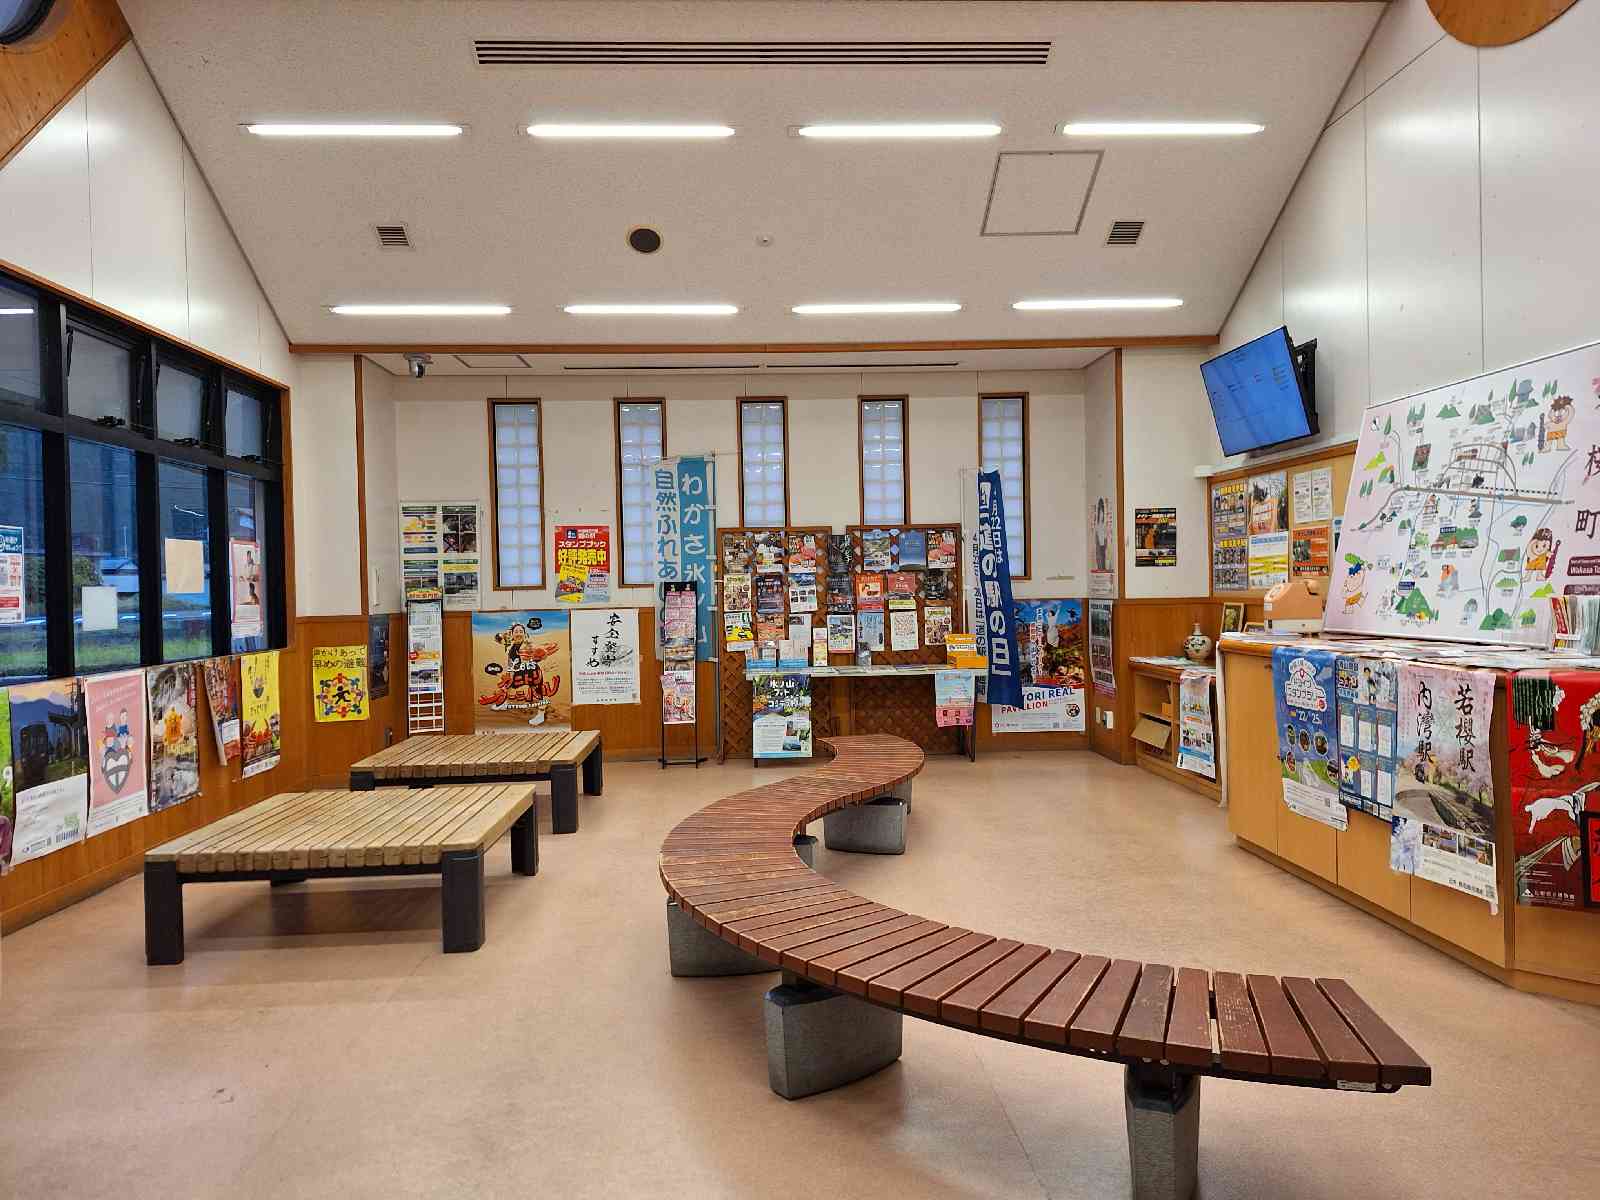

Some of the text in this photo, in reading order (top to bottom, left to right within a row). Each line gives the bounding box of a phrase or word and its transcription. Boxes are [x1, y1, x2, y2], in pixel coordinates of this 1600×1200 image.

[558, 548, 607, 567] 好評発売中
[1048, 686, 1076, 699] REAL
